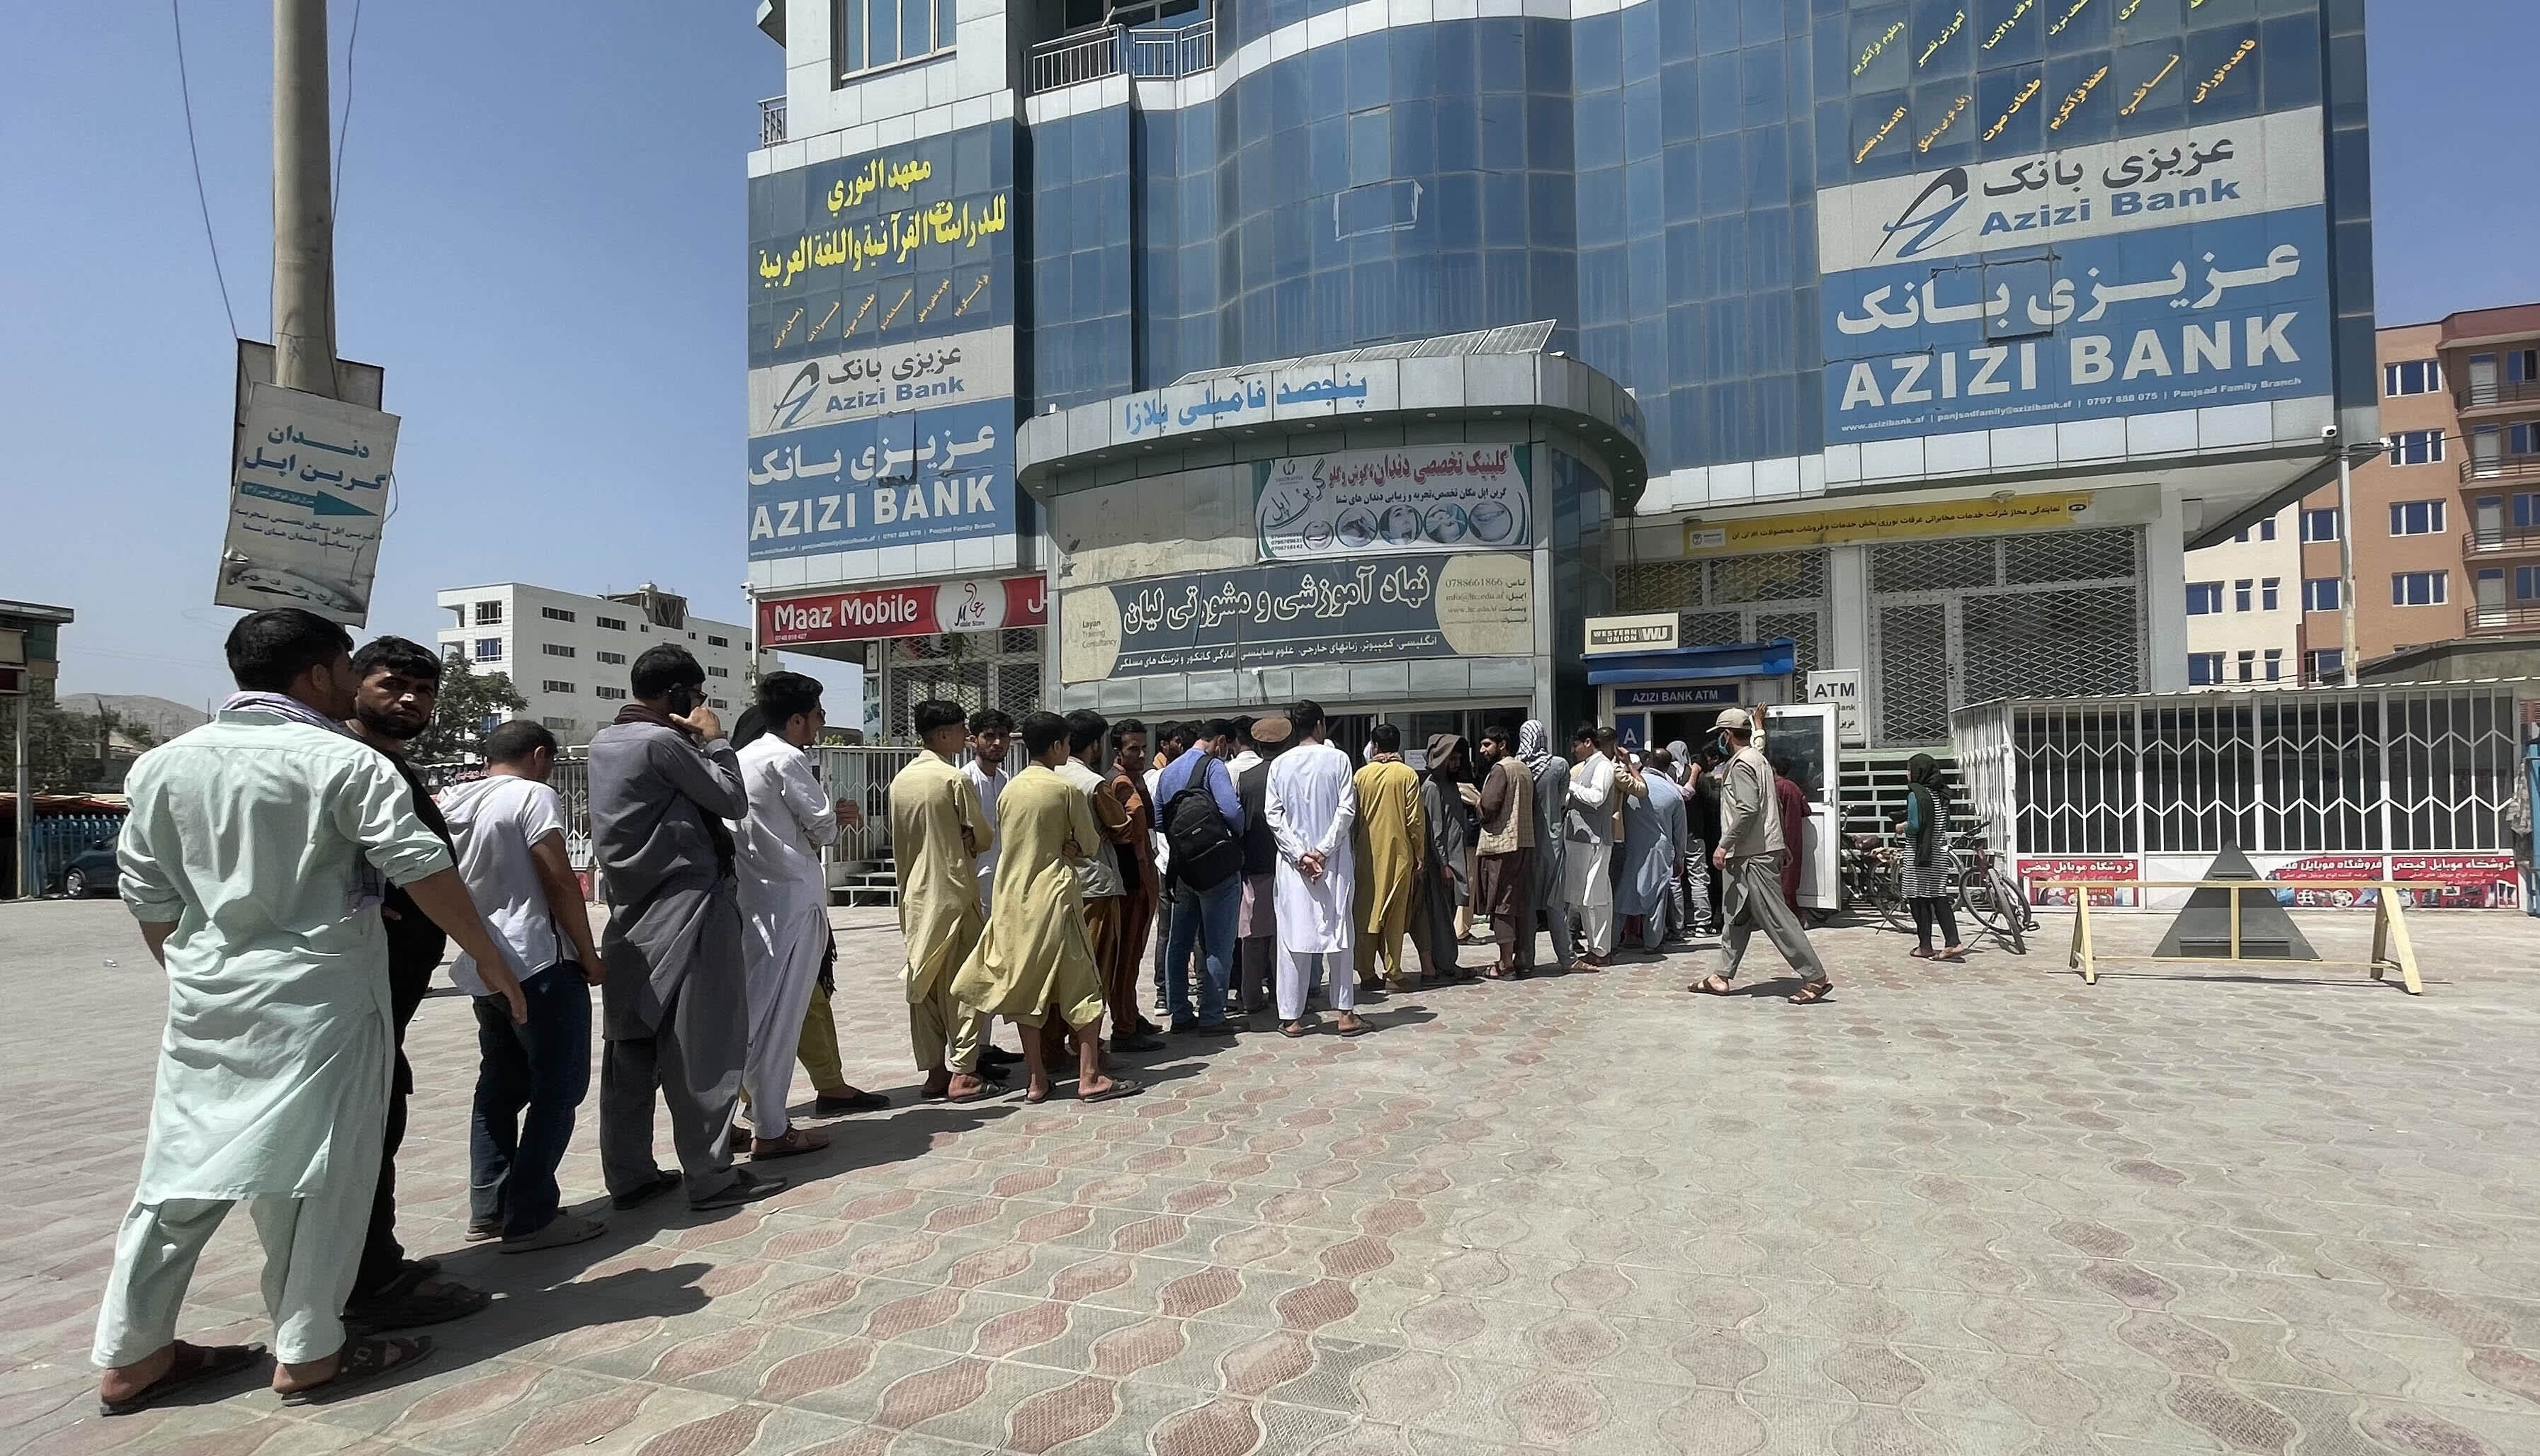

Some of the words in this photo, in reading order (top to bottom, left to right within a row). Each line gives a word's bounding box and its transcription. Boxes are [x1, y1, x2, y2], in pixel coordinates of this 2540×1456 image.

[888, 159, 931, 192] معهد
[1983, 157, 2084, 197] بانک
[2102, 138, 2235, 190] عزیزی
[827, 157, 885, 217] النوري
[1979, 198, 2090, 237] Azizi
[2111, 178, 2240, 217] Bank
[2027, 244, 2302, 325] عزیزی
[1836, 276, 2010, 335] بانک
[827, 357, 883, 385] بانک
[891, 346, 962, 382] عزیزی
[1840, 341, 2039, 411] AZIZI
[2070, 311, 2301, 386] BANK
[825, 387, 885, 414] Azizi
[895, 376, 965, 402] Bank
[1178, 380, 1266, 426] فامیلی
[1276, 372, 1368, 409] پنجصد
[1841, 414, 1925, 431] www.azizibank.af
[2087, 397, 2114, 406] 0797
[2221, 381, 2257, 392] Family
[2260, 377, 2301, 388] Branch
[1126, 398, 1169, 436] پلازا
[268, 424, 370, 459] دندان
[850, 425, 995, 482] عزیزی
[748, 443, 841, 487] بانک
[749, 492, 856, 541] AZIZI
[873, 474, 996, 525] BANK
[1274, 564, 1376, 620] آموزشی
[1380, 566, 1430, 608] نهاد
[775, 604, 832, 632] Maaz
[841, 594, 918, 627] Mobile
[1082, 620, 1101, 630] Layan
[1254, 591, 1271, 623] و
[1276, 645, 1294, 659] علوم
[1593, 629, 1638, 637] WESTERN
[1642, 627, 1668, 640] WU
[1632, 691, 1659, 703] AZIZI
[1662, 690, 1695, 703] BANK
[1695, 689, 1718, 701] ATM
[1814, 683, 1854, 698] ATM
[1623, 728, 1638, 744] A
[2054, 860, 2088, 873] موبایل
[2090, 860, 2134, 873] فروشگاه
[2301, 860, 2335, 871] موبایل
[2337, 858, 2383, 870] فروشگاه
[2429, 858, 2463, 871] موبایل
[2466, 857, 2515, 871] فروشگاه
